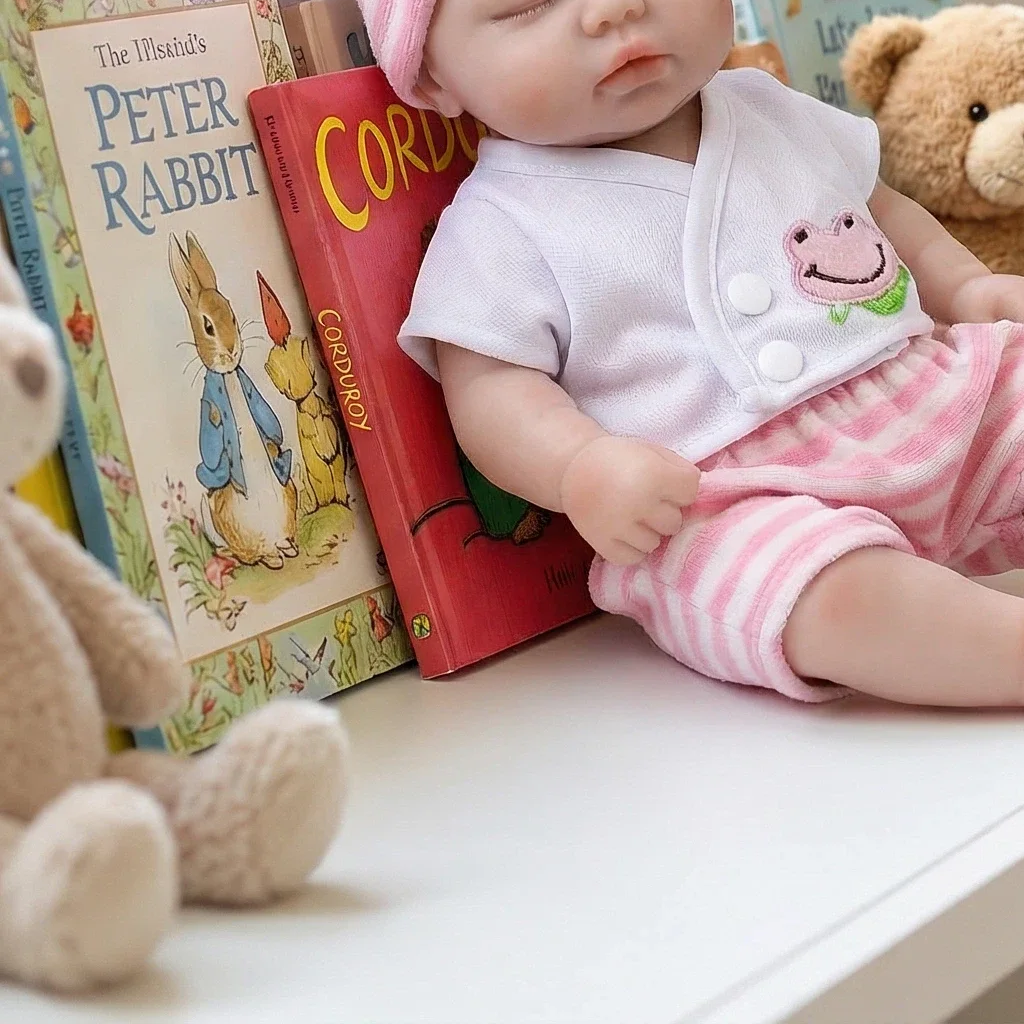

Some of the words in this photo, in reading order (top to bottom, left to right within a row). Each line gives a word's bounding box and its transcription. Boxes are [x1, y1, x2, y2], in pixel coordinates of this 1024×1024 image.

[94, 41, 132, 69] The
[84, 75, 240, 152] PETER
[91, 141, 260, 236] RABBIT
[317, 309, 373, 431] CORDUROY
